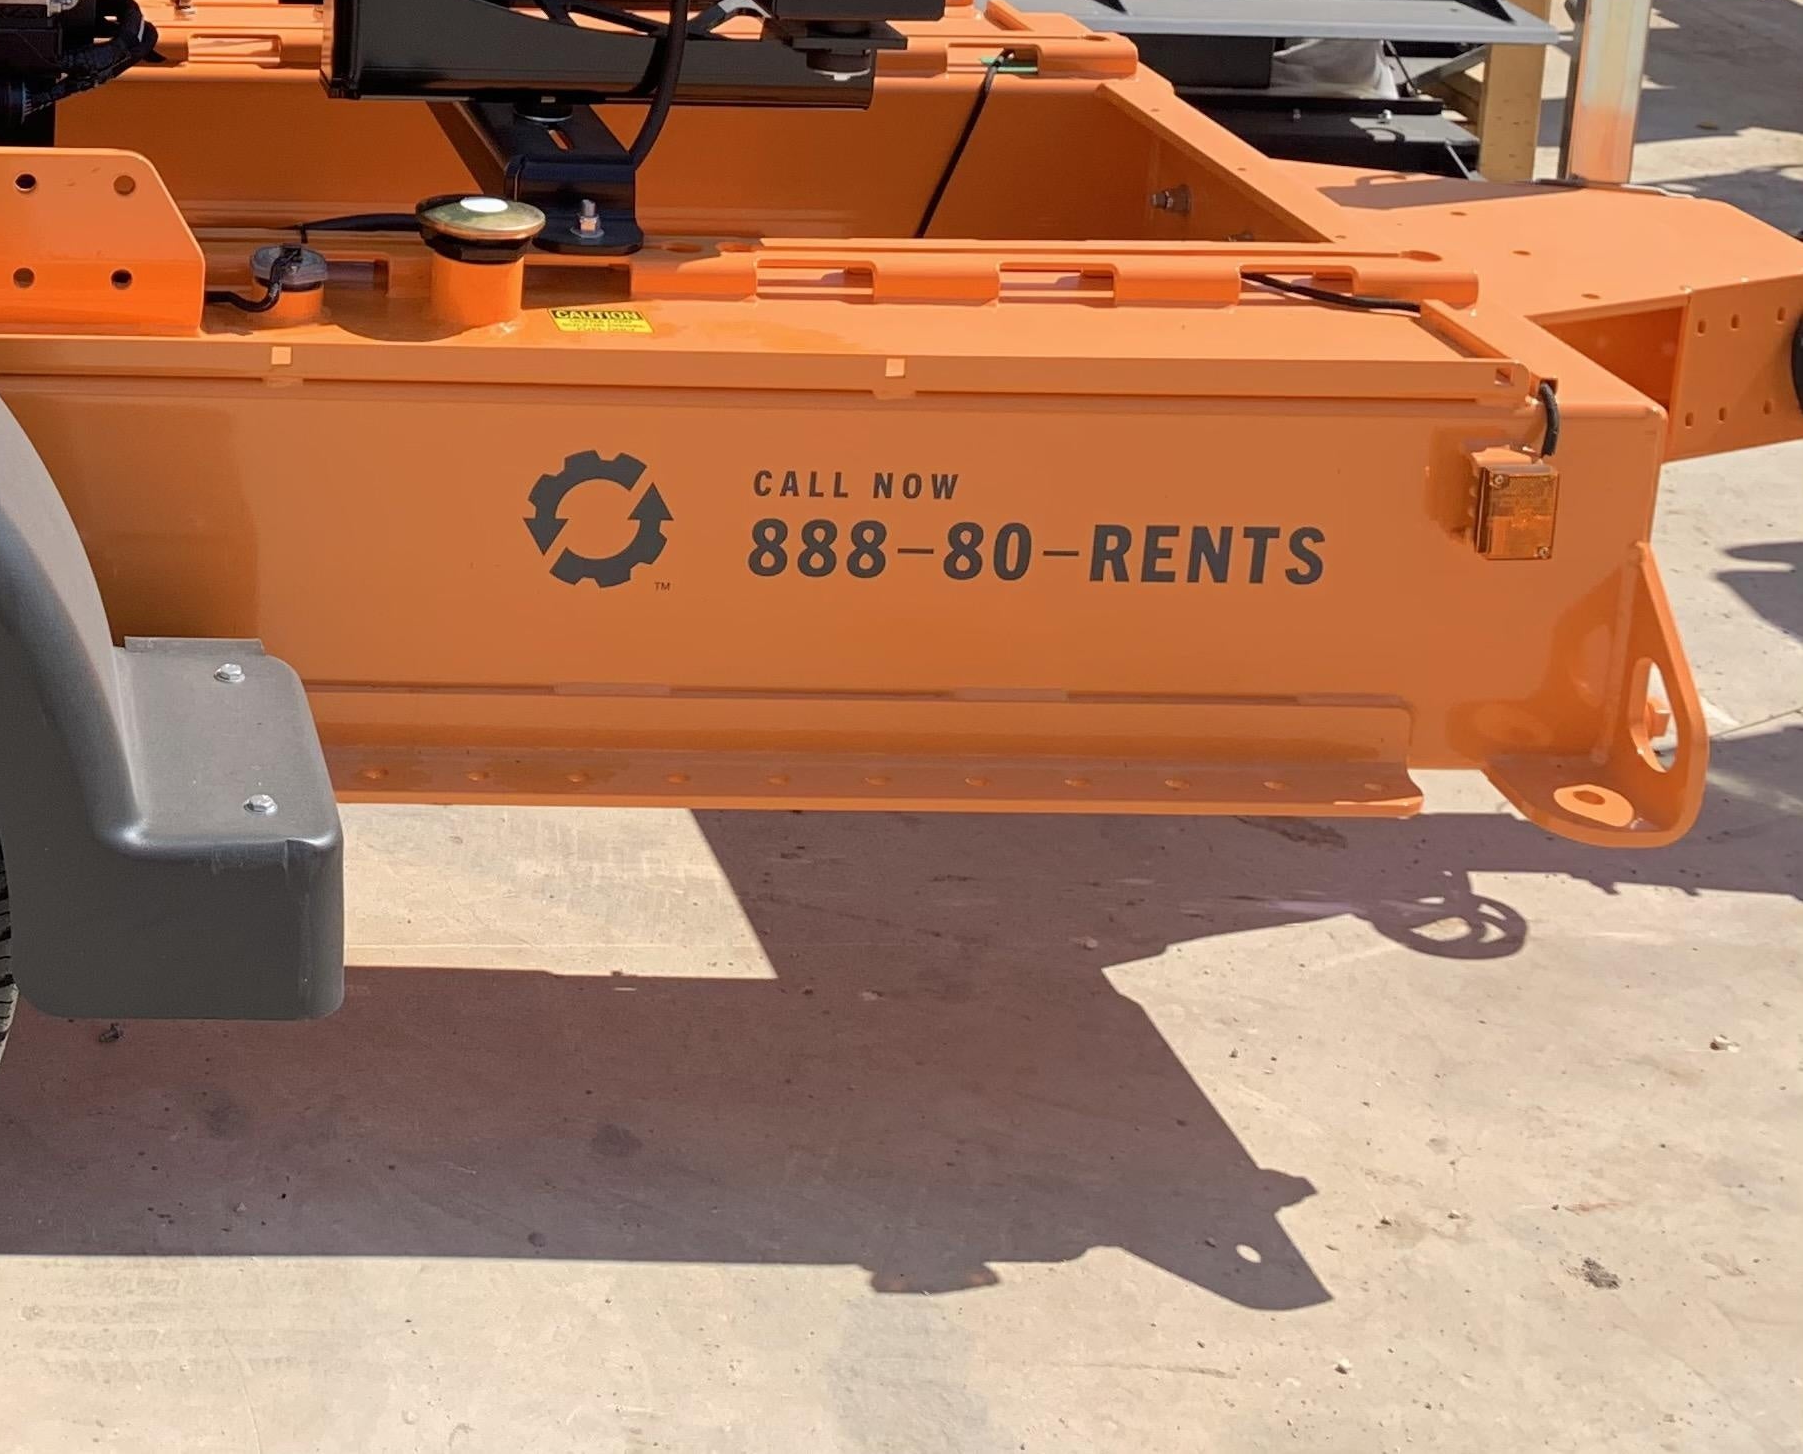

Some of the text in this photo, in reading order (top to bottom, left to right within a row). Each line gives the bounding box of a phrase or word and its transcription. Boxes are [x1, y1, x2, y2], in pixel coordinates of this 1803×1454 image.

[555, 310, 639, 319] CAUTION
[753, 470, 958, 500] CALL NOW
[747, 518, 1326, 586] 888-80-RENTS
